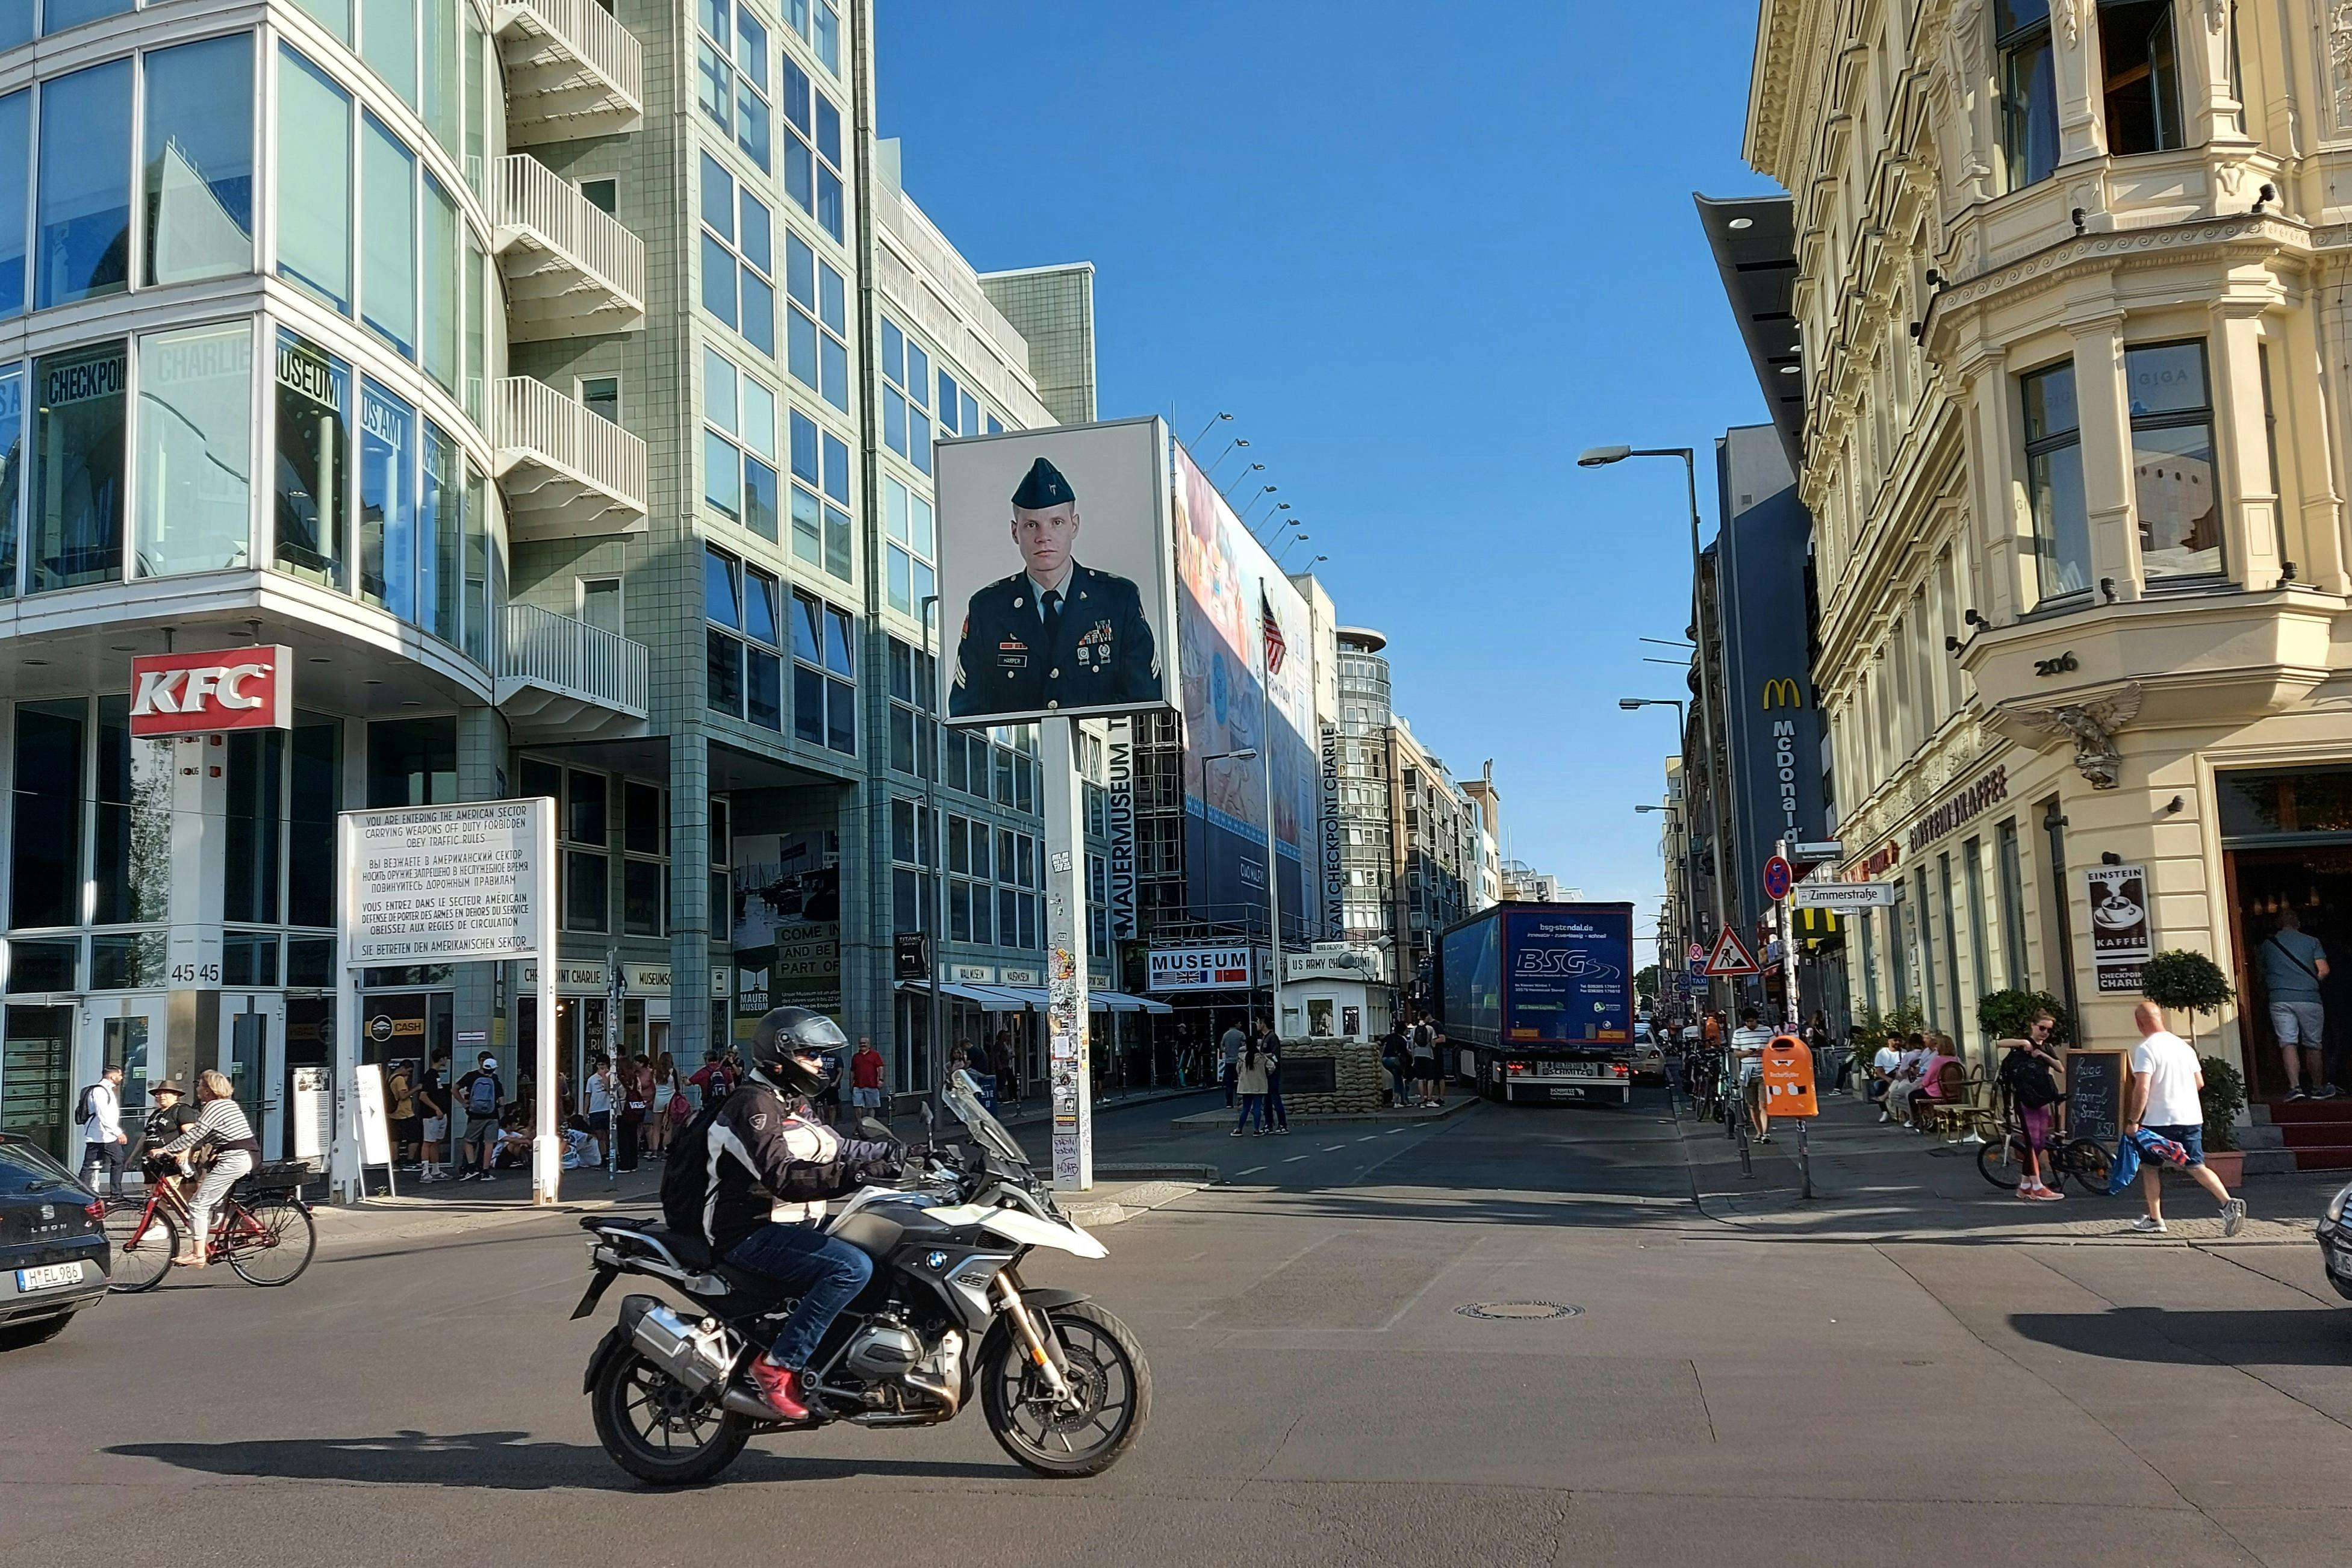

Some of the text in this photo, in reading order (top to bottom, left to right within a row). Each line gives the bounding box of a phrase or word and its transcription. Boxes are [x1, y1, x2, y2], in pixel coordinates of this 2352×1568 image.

[276, 347, 340, 411] USEUM
[2033, 652, 2078, 677] 206
[129, 664, 274, 716] KFC
[1268, 674, 1278, 695] ROM
[1773, 721, 1803, 843] McDonald'
[1958, 764, 2008, 823] KAFFEE
[366, 806, 526, 826] YOU ARE ENTERING THE AMERICAN SECTOR
[366, 818, 525, 838] CARRYING WEAPONS OFF DUTY FORBIDDEN
[1322, 727, 1342, 926] AM CHECKPOINT CHARLIE
[406, 833, 485, 848] OBEY TRAFFIC RULES
[1110, 742, 1135, 933] MAUERMUSEUM
[369, 859, 381, 869] ВЫ
[425, 856, 429, 865] В
[433, 850, 492, 865] АМЕРИКАНСКИЙ
[496, 849, 522, 860] СЕКТОР
[362, 871, 385, 882] НОСИТЬ
[453, 866, 457, 876] В
[507, 861, 528, 873] ВРЕМЯ
[2088, 869, 2142, 880] EINSTEIN
[426, 877, 470, 889] ДОРОЖНЫМ
[474, 875, 516, 886] ПРАВИЛАМ
[362, 901, 382, 912] VOUS
[386, 900, 411, 910] ENTREZ
[415, 898, 434, 908] DANS
[438, 897, 446, 907] LE
[449, 895, 482, 906] SECTEUR
[1810, 888, 1878, 901] Zimmerstraße
[362, 904, 529, 924] DEFENSE DE PORTER DES ARMES EN DEHORS DU SERVICE
[370, 917, 518, 935] OBEISSEZ AUX REGLES DE CIRCULATION
[781, 926, 823, 941] COME
[362, 936, 527, 956] SIE BETRETEN DEN AMERIKANISCHEN SEKTOR
[2097, 937, 2146, 947] KAFFEE
[784, 945, 831, 959] AND BE
[1515, 948, 1588, 973] BSG
[781, 960, 839, 974] PART OF
[1152, 953, 1246, 970] MUSEUM
[1292, 959, 1303, 970] US
[1306, 958, 1326, 970] ARMY
[1328, 956, 1370, 969] CHOINT
[172, 964, 219, 982] 45 45
[571, 970, 600, 984] CHARLIE
[2100, 978, 2142, 988] CHARLI
[740, 994, 768, 1003] MAUER
[740, 1002, 768, 1011] MUSEUM
[394, 1022, 422, 1032] CASH
[31, 1223, 67, 1233] LEON
[30, 1265, 78, 1285] H EL 986
